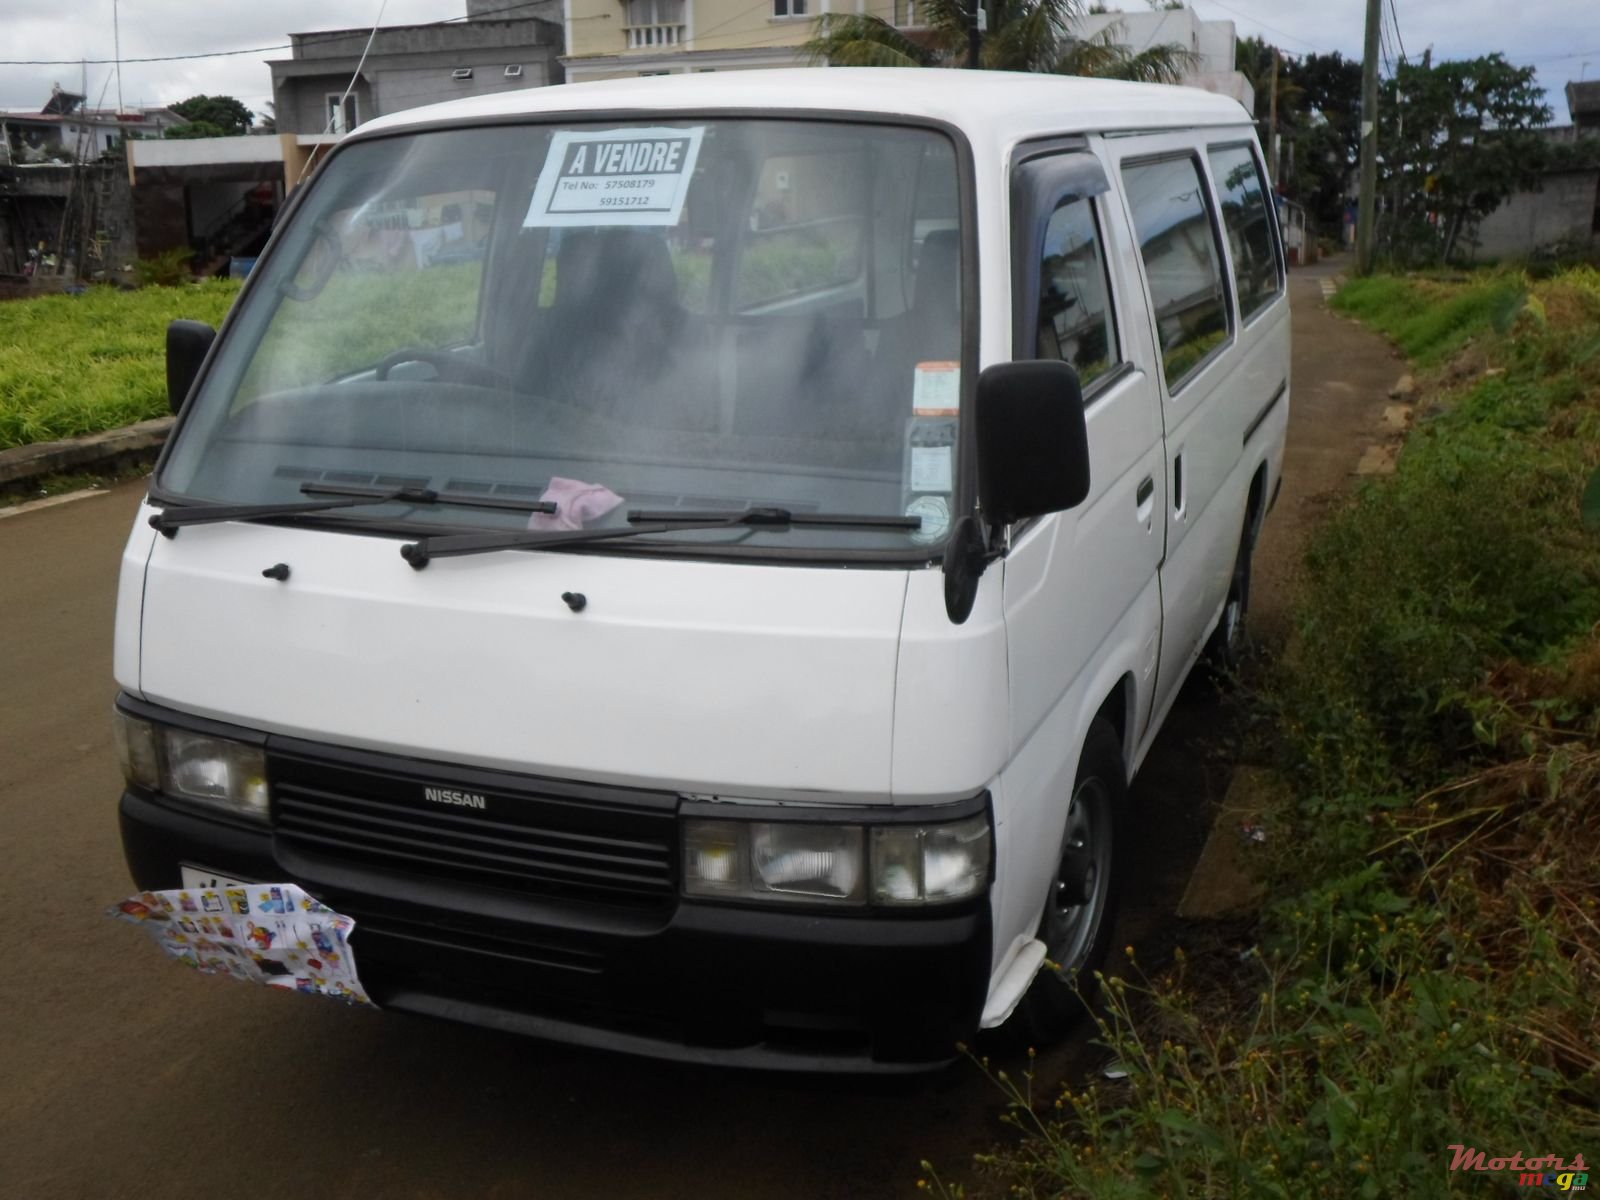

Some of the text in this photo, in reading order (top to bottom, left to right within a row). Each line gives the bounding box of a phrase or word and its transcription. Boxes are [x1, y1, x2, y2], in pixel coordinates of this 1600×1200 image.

[568, 141, 683, 175] A VENDRE
[562, 179, 655, 190] Tel No: 57508179
[600, 196, 650, 206] 59151712
[424, 787, 486, 809] NISSAN
